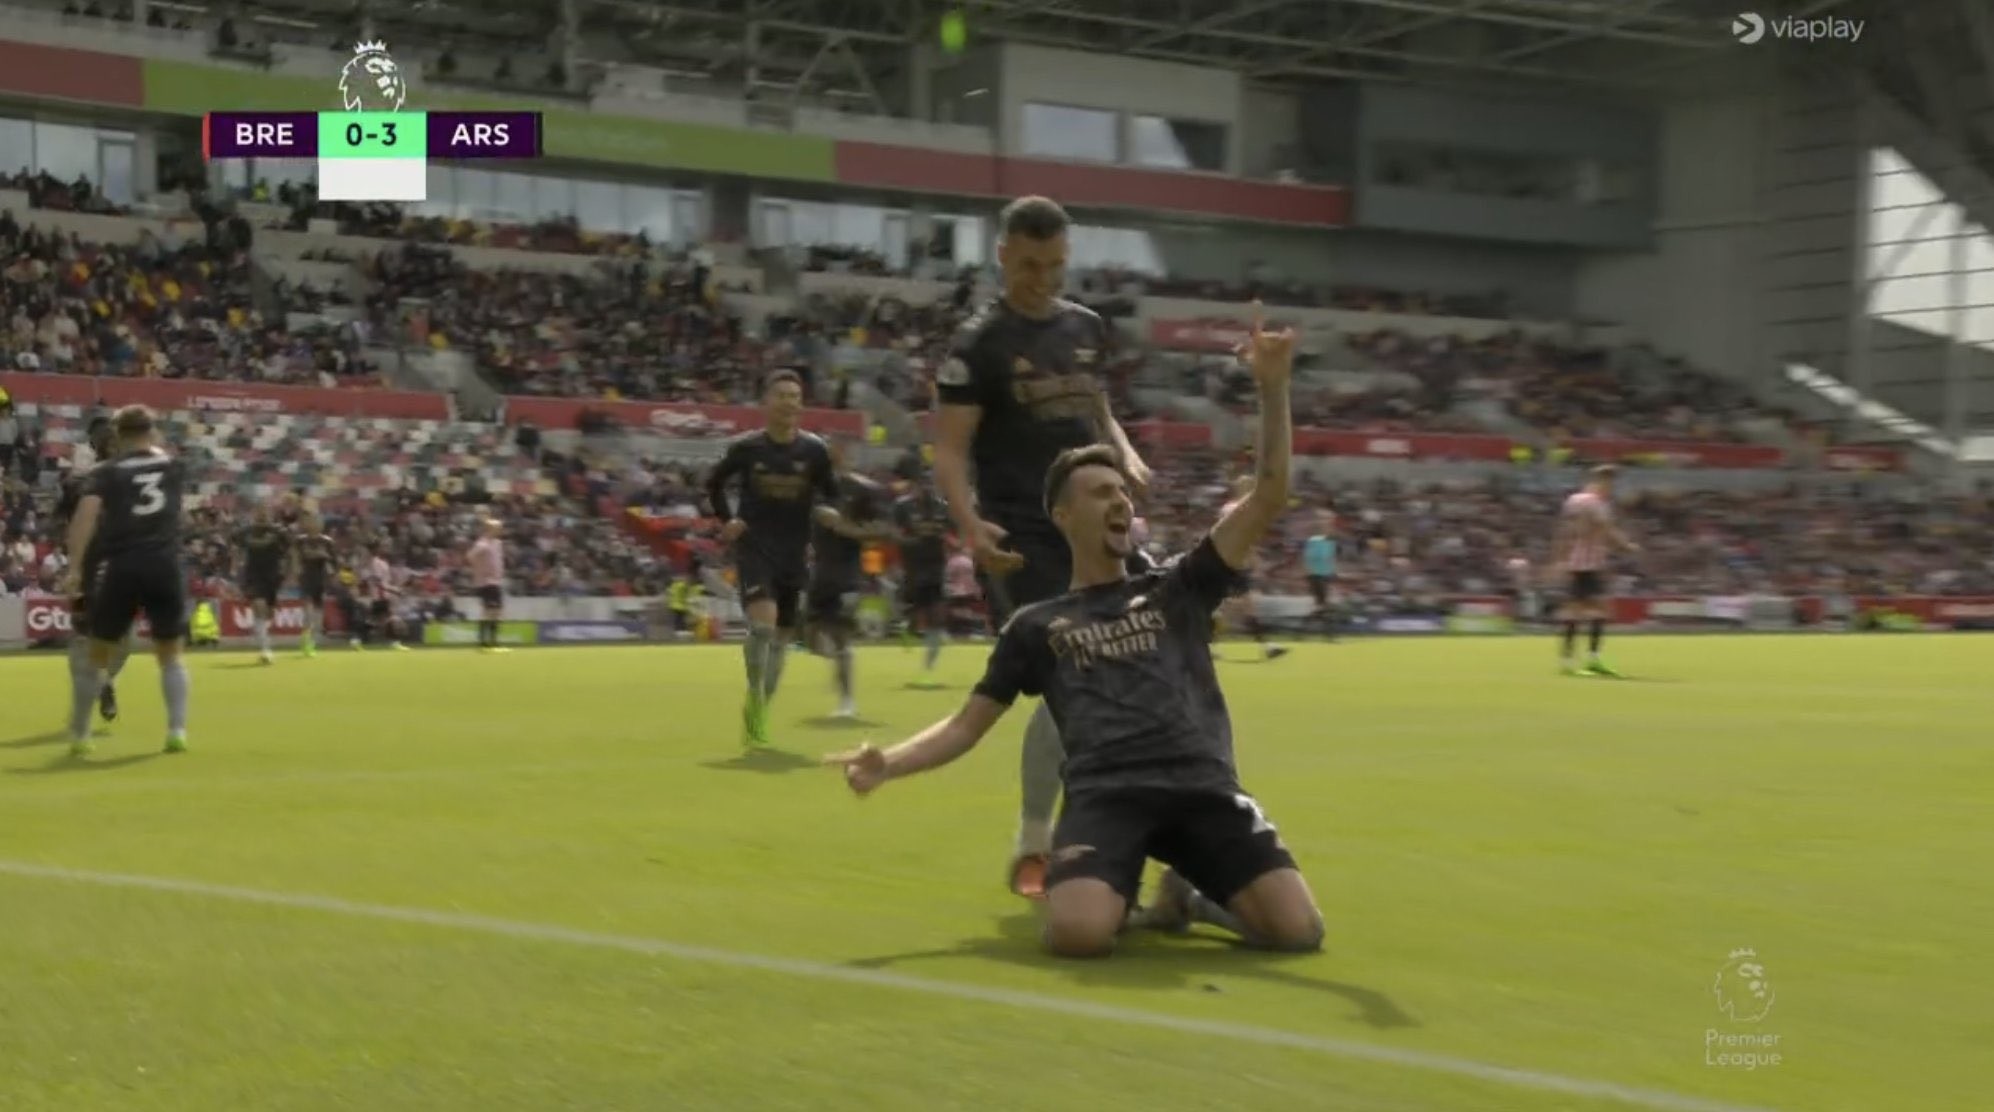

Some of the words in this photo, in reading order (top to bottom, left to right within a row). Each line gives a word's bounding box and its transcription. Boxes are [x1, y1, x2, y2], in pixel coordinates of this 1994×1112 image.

[131, 472, 166, 516] 3
[1048, 610, 1166, 658] Emirates
[1101, 631, 1159, 657] BETTER
